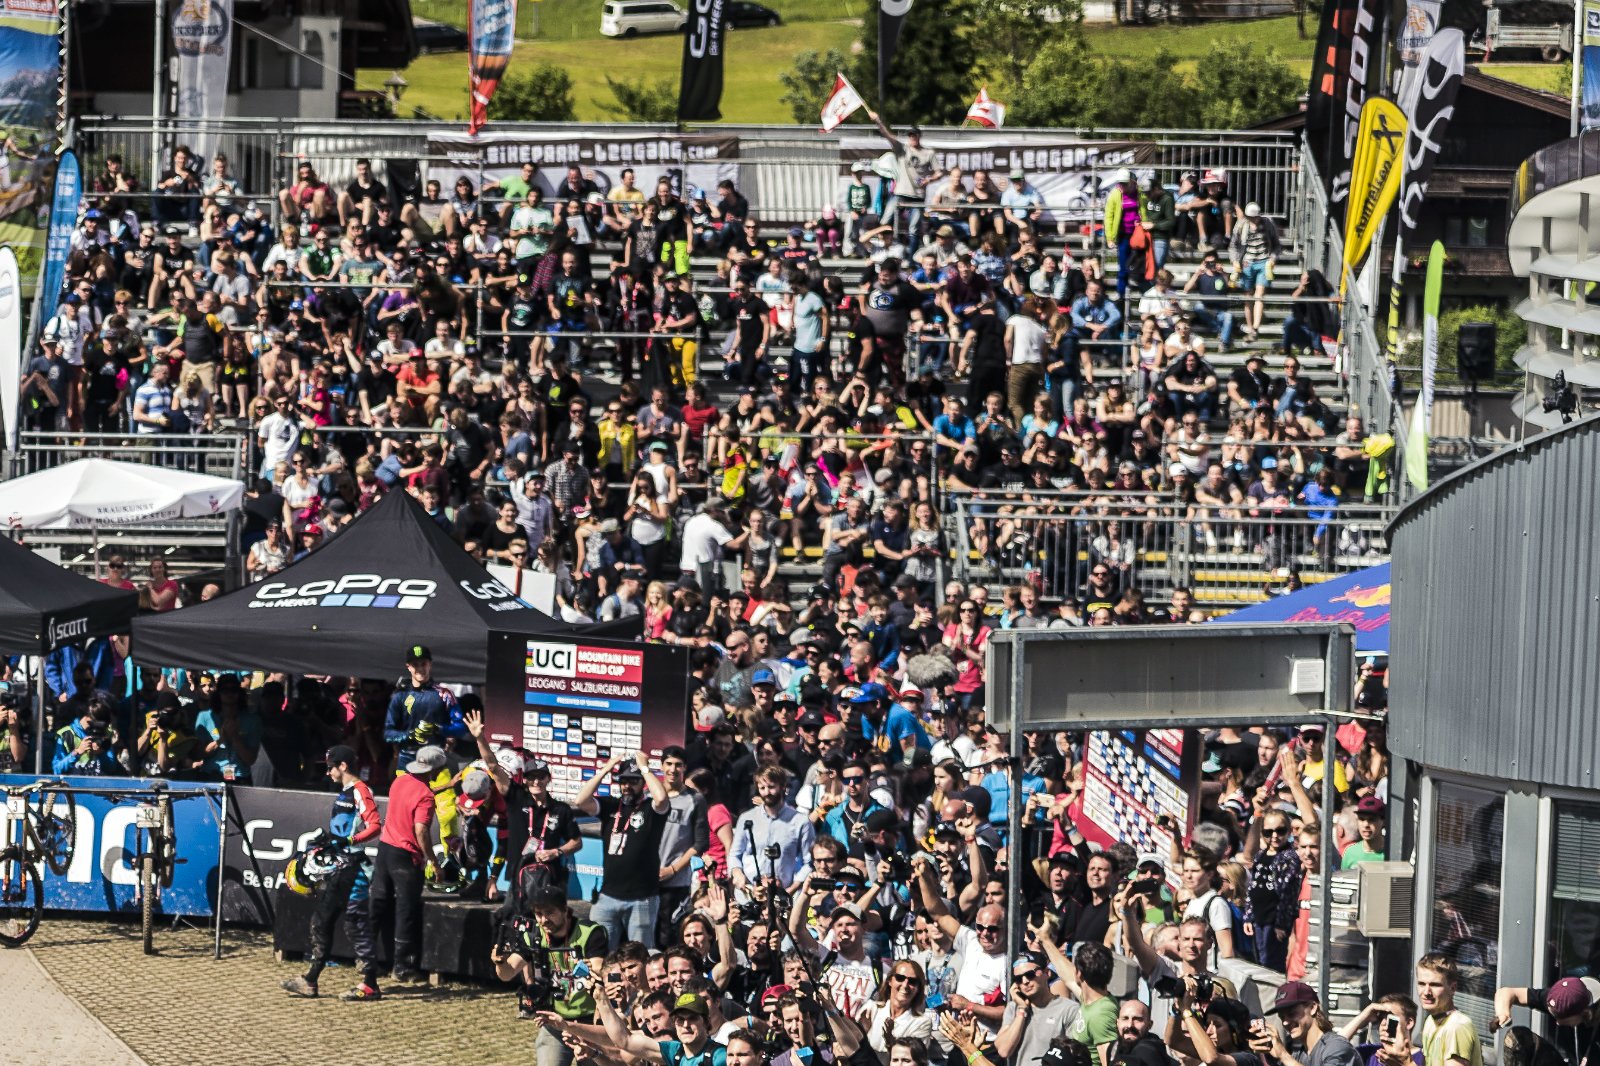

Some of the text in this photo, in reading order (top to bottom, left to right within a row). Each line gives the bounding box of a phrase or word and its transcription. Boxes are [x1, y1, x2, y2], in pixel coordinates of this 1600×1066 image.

[1343, 0, 1375, 159] SCOT
[255, 574, 438, 600] GoPro
[54, 618, 89, 640] SCOTT
[535, 649, 572, 670] UCI
[577, 651, 642, 667] MOUNTAIN BIKE
[577, 664, 626, 677] WORLD CUP
[528, 677, 640, 697] LEOGANG SALZBURGERLAND
